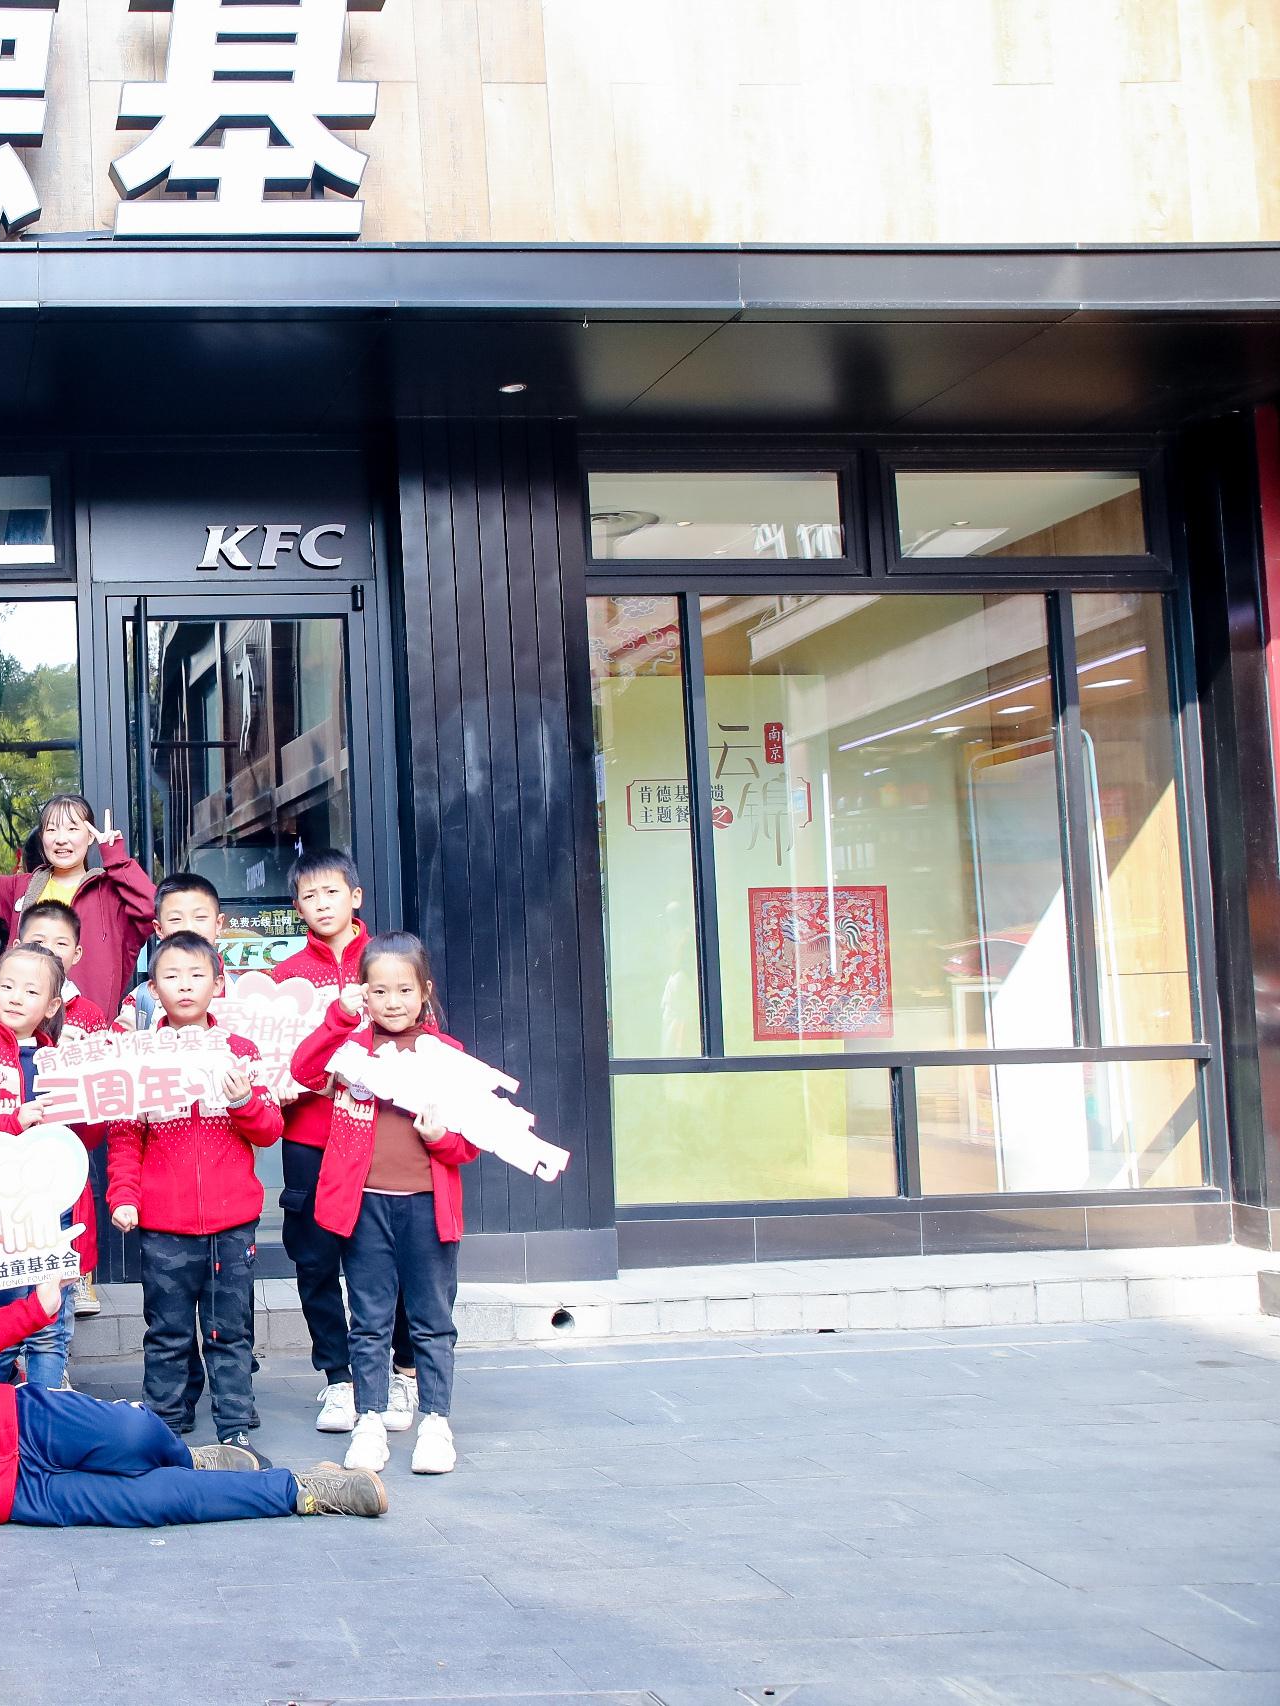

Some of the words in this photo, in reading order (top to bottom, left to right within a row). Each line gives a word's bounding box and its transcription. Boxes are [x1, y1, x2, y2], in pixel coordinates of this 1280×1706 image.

[196, 524, 347, 571] KFC
[767, 725, 784, 761] 南京
[638, 785, 725, 804] 肯德基遗
[639, 806, 691, 824] 主题餐
[228, 916, 293, 928] 免费无线上网
[214, 940, 289, 967] KFC
[36, 1029, 228, 1074] 肯德基小候鸟基金
[37, 1066, 187, 1125] 三周年
